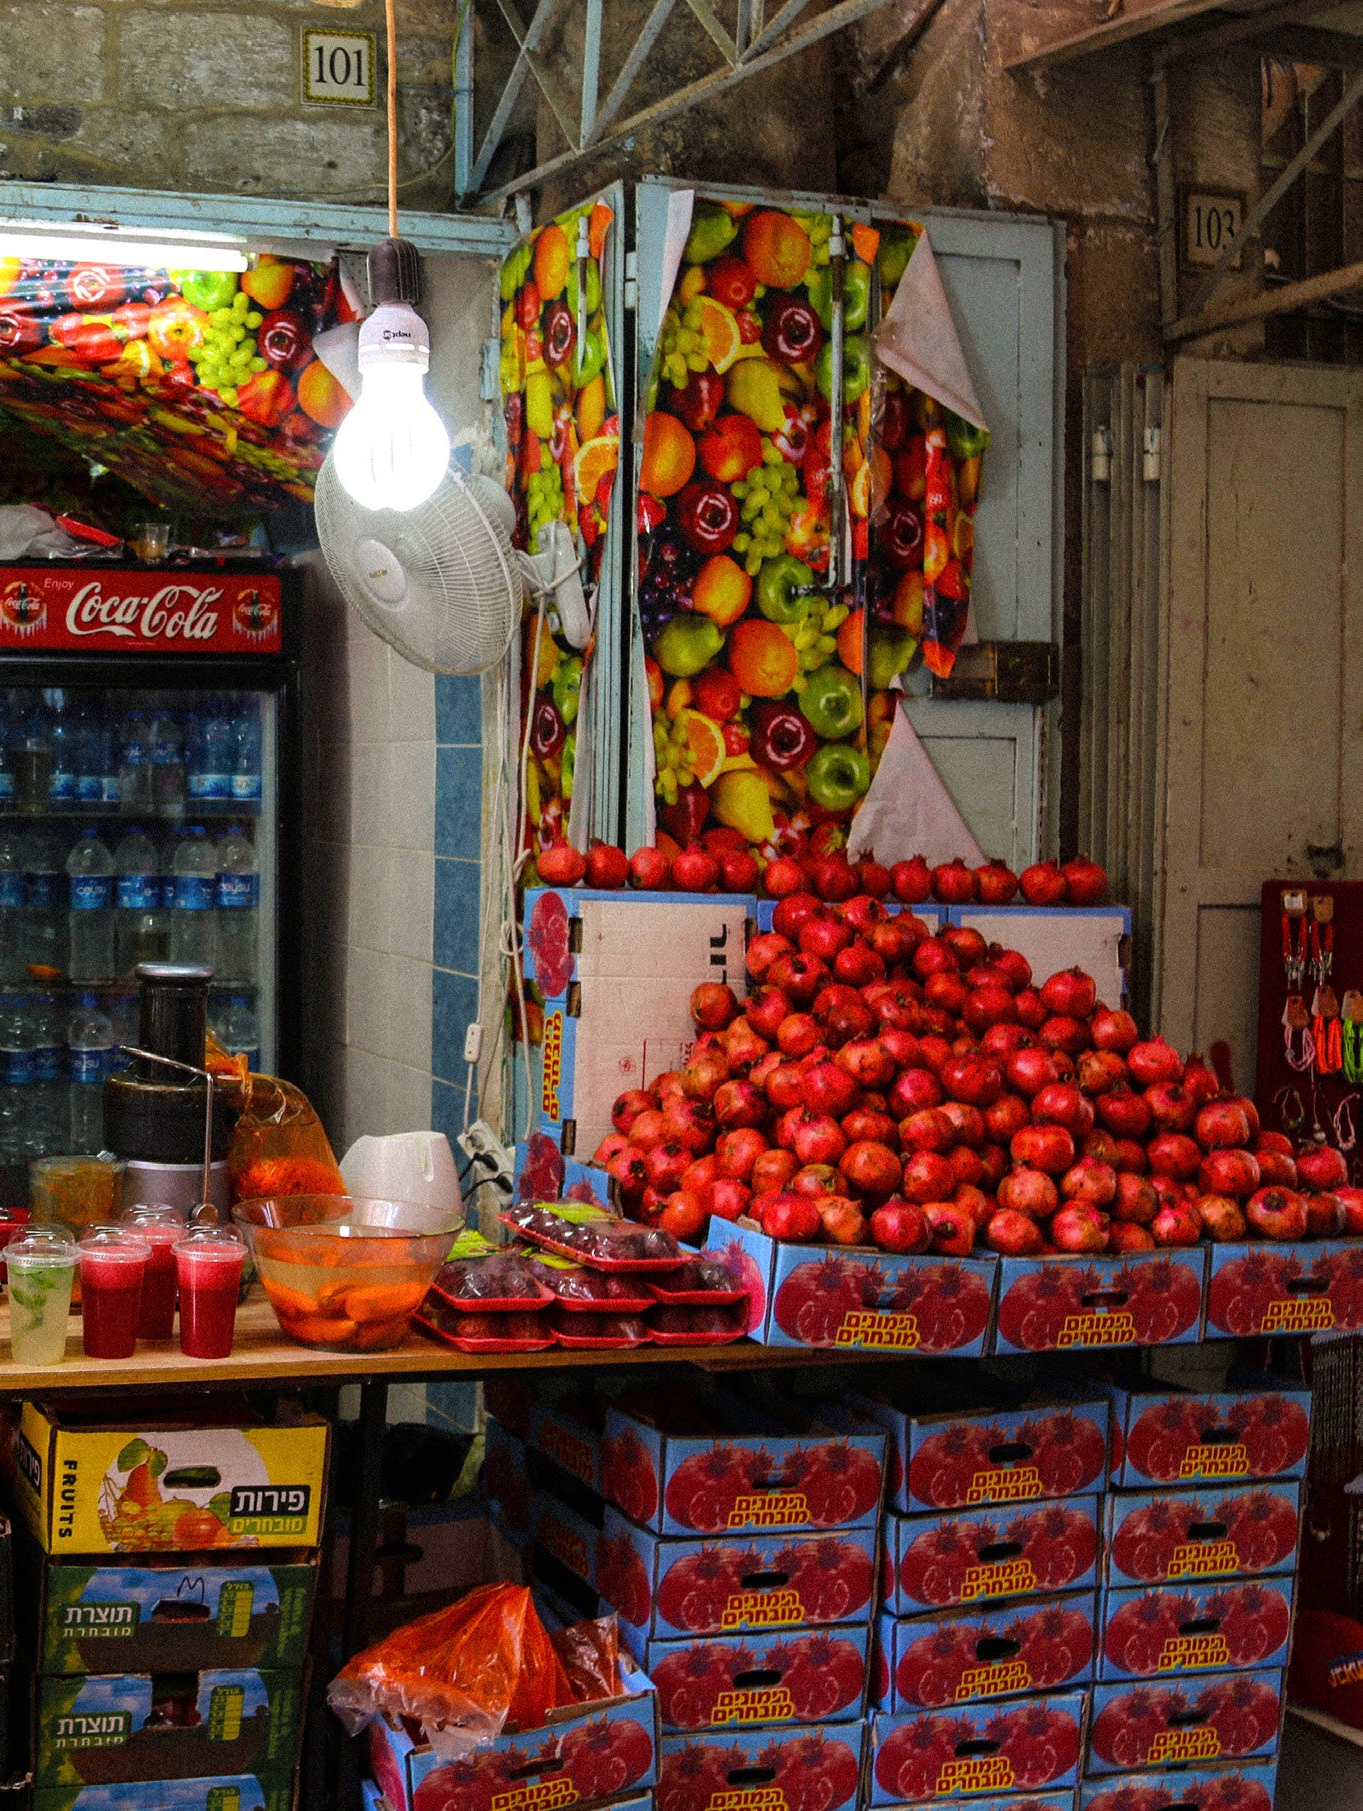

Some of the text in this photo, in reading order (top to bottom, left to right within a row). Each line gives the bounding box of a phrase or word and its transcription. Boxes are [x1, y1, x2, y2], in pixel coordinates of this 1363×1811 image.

[315, 46, 366, 86] 101
[1195, 206, 1235, 249] 103
[44, 578, 75, 591] Enjoy
[66, 581, 225, 640] Coca-Cola
[1262, 1315, 1334, 1330] מובחרים
[837, 1329, 918, 1346] מובחרים
[1058, 1329, 1135, 1345] מובחרים
[1180, 1460, 1249, 1476] מובחרים
[59, 1460, 77, 1538] FRUITS
[234, 1490, 305, 1512] פירות
[968, 1483, 1042, 1502] מובחרים
[233, 1518, 303, 1533] מובחרים
[730, 1510, 810, 1526] מובחרים
[1169, 1557, 1239, 1576] מובחרים
[962, 1575, 1036, 1598] מובחרים
[65, 1606, 132, 1623] תוצרת
[723, 1607, 804, 1625] מובחרים
[63, 1627, 131, 1637] מובחרת
[1159, 1650, 1229, 1669] מובחרים
[957, 1676, 1031, 1700] מובחרים
[712, 1704, 794, 1721] מובחרים
[57, 1716, 124, 1735] תוצרת
[56, 1736, 123, 1748] מובחרת
[1149, 1743, 1220, 1762] מובחרים
[937, 1771, 1014, 1793] מובחרים
